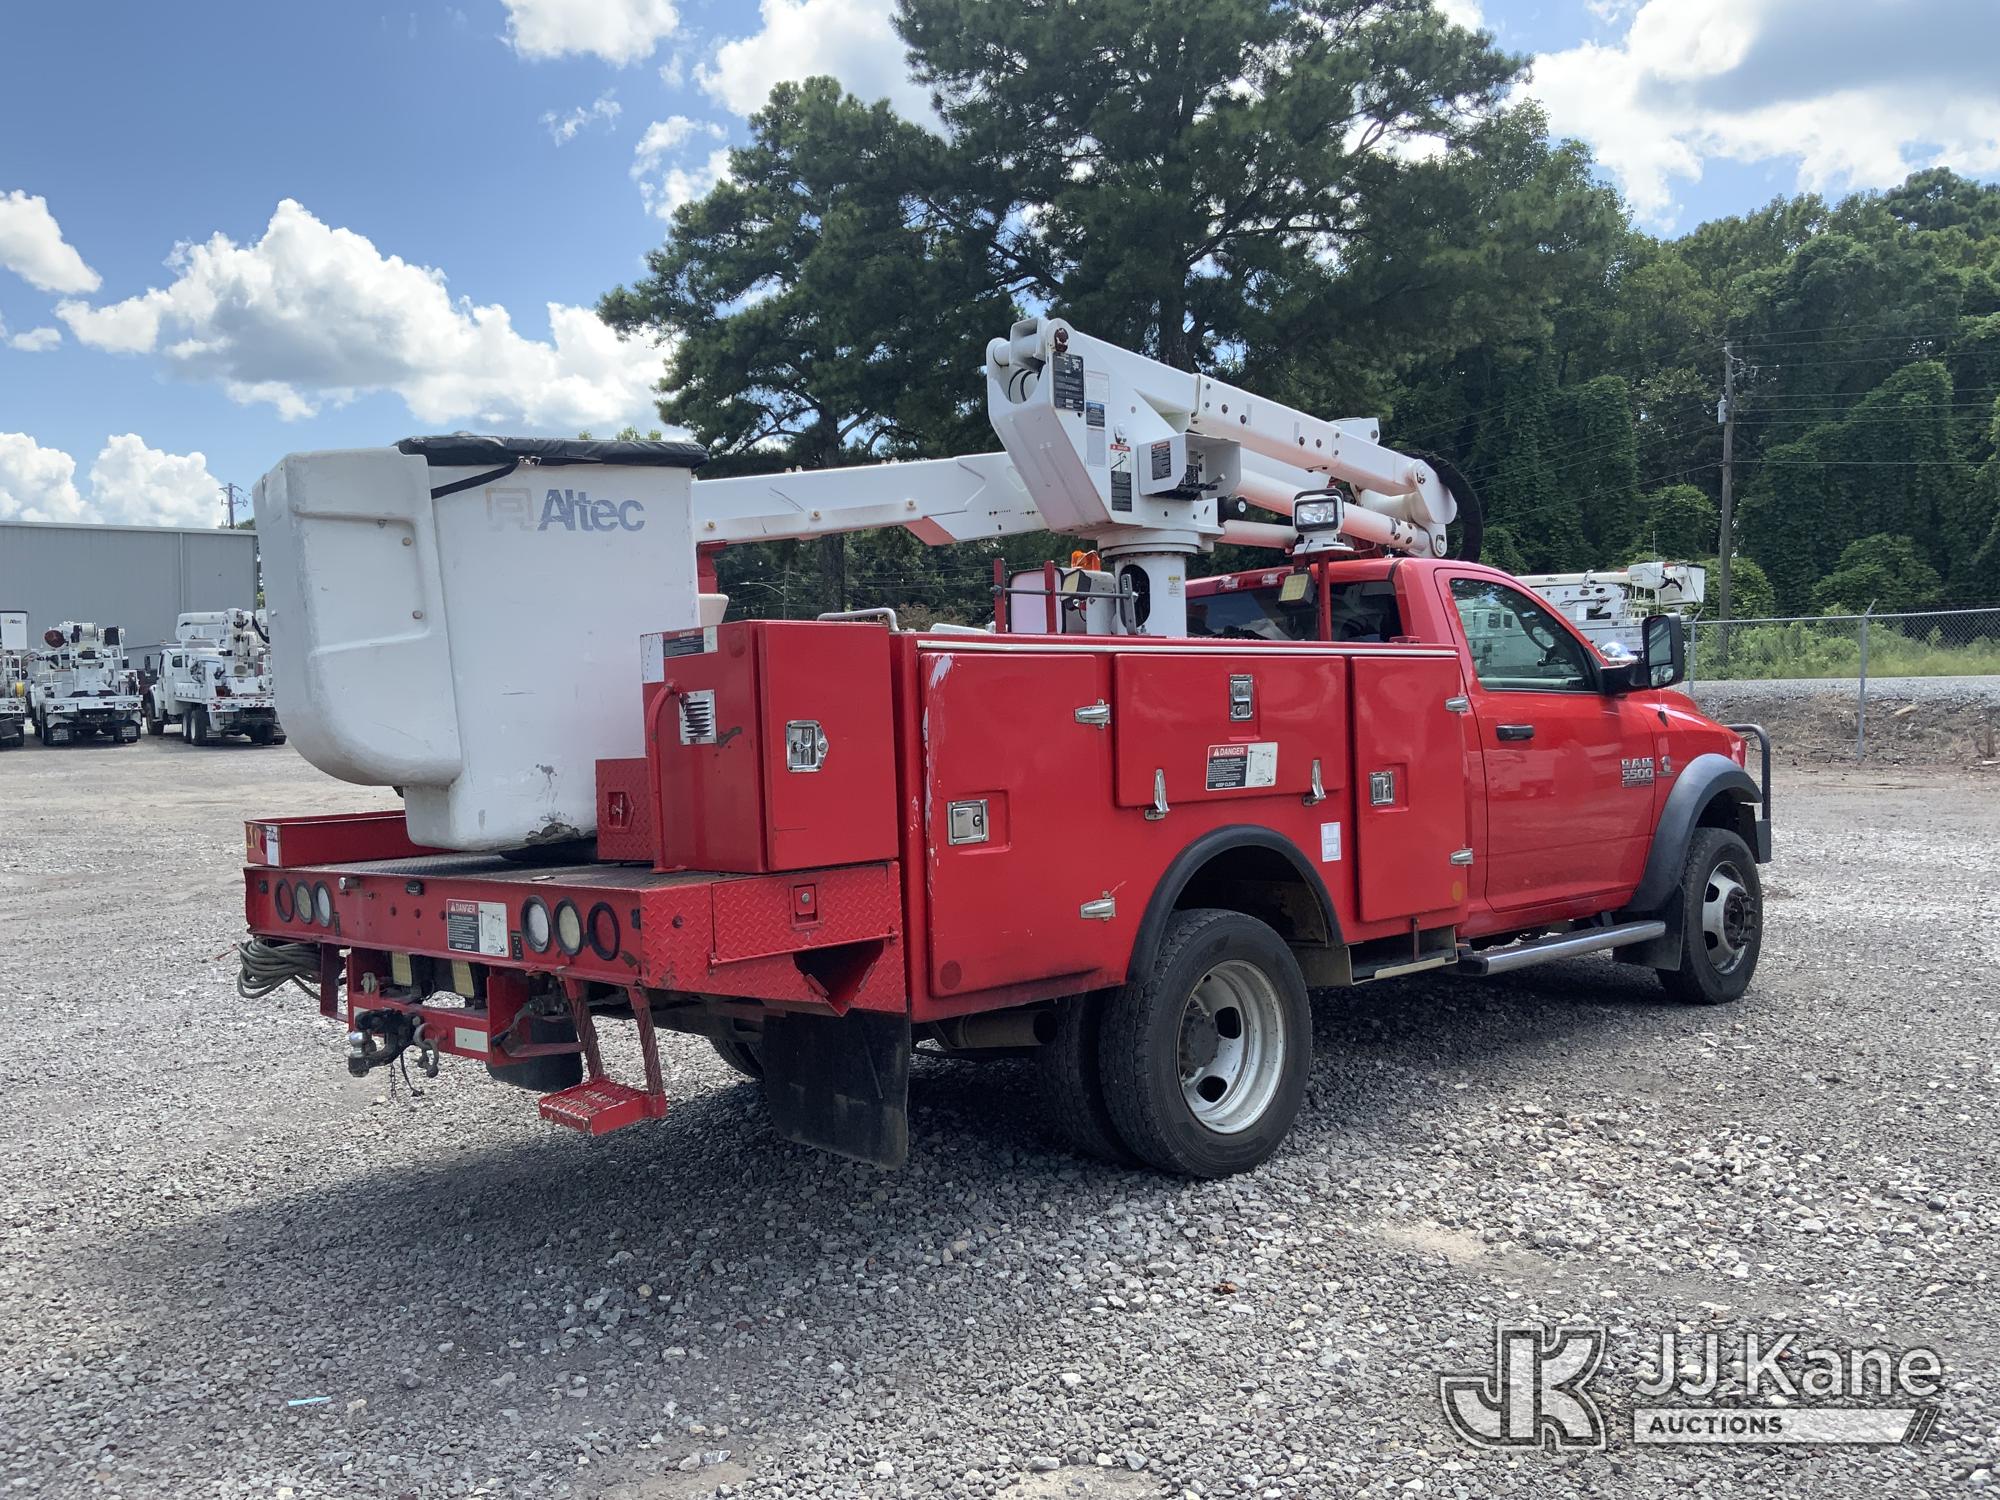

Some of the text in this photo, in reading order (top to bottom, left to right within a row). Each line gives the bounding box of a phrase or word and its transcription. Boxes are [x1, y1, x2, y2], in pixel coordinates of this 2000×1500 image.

[537, 489, 645, 531] Altec
[1220, 747, 1245, 756] DANGER
[1621, 757, 1653, 769] RAM
[1622, 767, 1653, 780] 5500
[455, 903, 476, 914] DANGER
